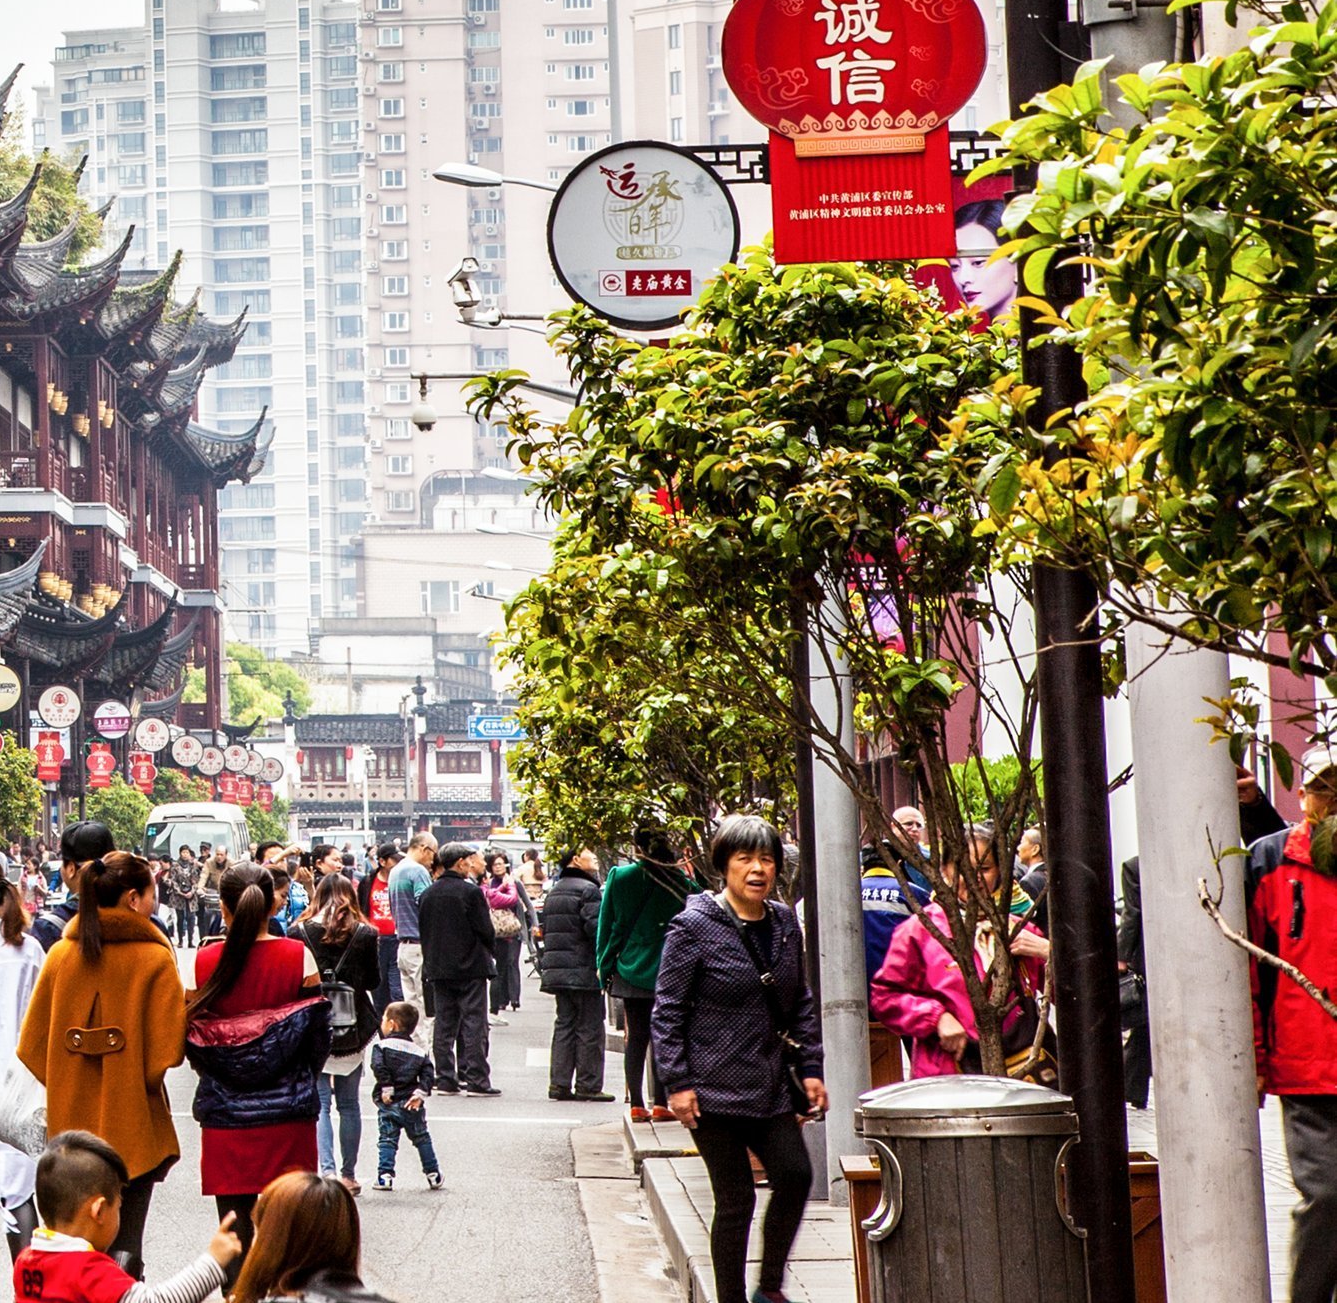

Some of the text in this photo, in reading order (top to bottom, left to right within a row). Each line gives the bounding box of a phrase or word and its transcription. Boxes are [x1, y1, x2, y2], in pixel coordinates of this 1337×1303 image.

[819, 190, 914, 204] 中共黄浦区委宣传部
[789, 203, 946, 221] 黄浦区精神文明建设委员会办公室
[631, 275, 687, 291] 老庙黄金
[861, 888, 900, 903] 停车管理
